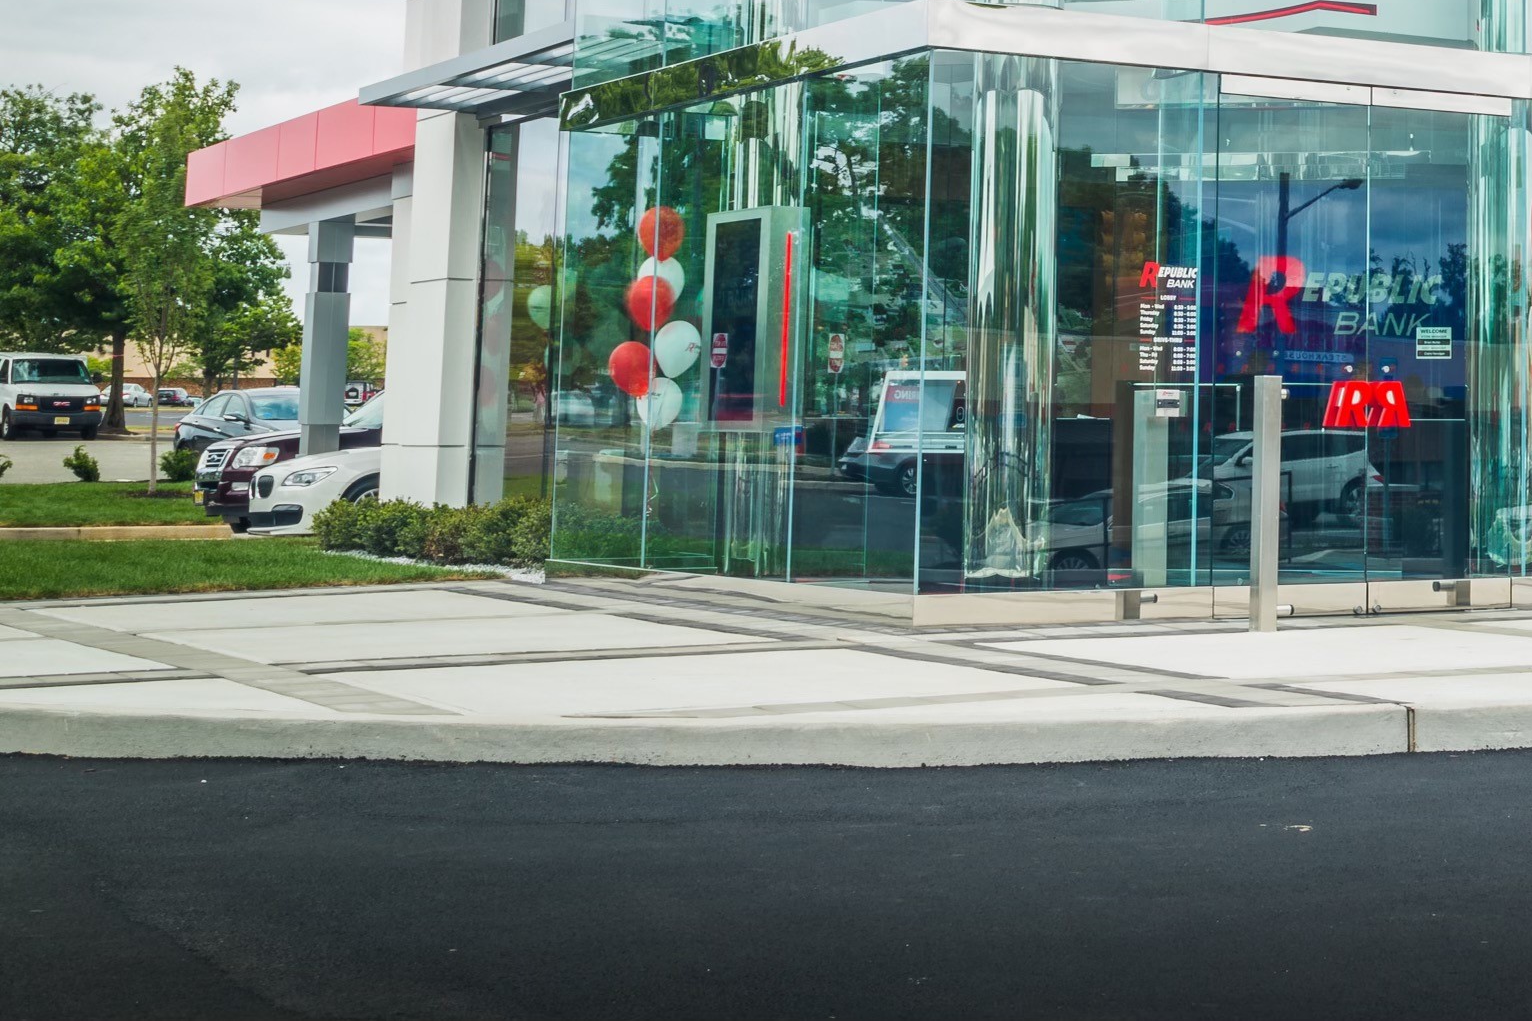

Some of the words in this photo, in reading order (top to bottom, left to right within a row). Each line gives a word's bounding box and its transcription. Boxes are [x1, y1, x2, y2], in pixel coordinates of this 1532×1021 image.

[1139, 261, 1198, 288] REPUBLIC
[1166, 279, 1195, 288] BANK
[1236, 255, 1442, 334] REPUBLIC
[1333, 311, 1431, 336] BANK
